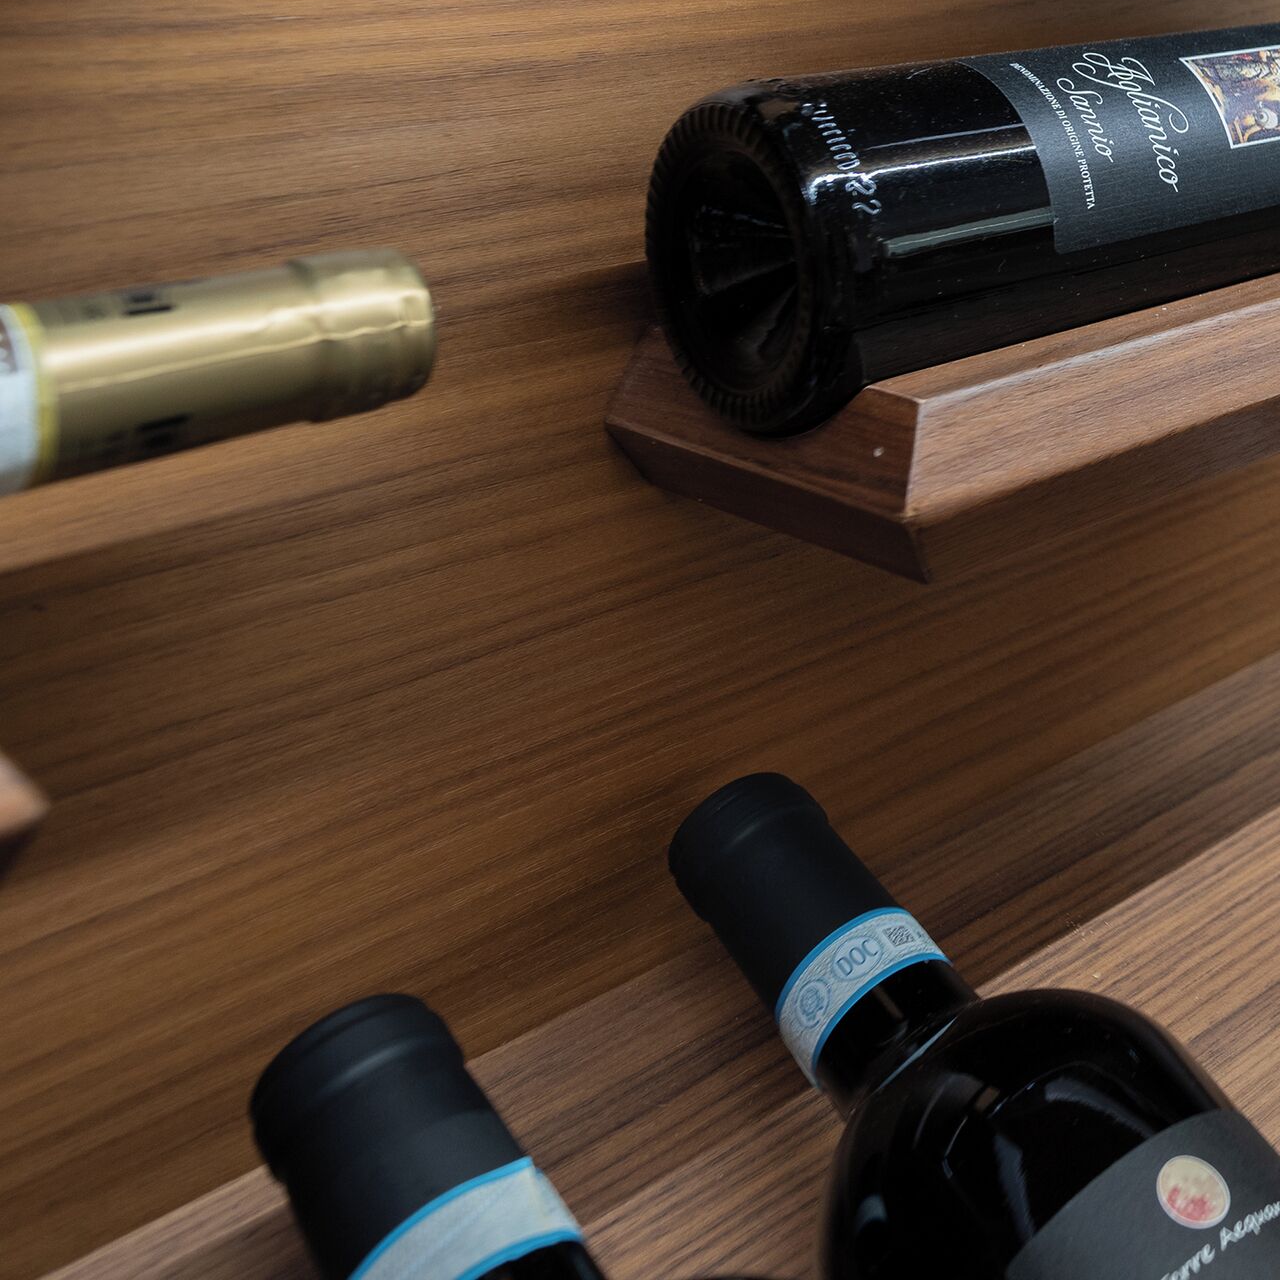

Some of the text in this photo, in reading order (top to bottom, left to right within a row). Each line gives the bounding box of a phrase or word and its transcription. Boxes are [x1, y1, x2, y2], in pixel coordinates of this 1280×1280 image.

[1056, 77, 1114, 163] Sannio
[1059, 116, 1083, 159] ORIGINE
[1078, 157, 1095, 209] PROTETTA
[1072, 52, 1189, 193] Aglianico
[835, 939, 879, 977] DOC
